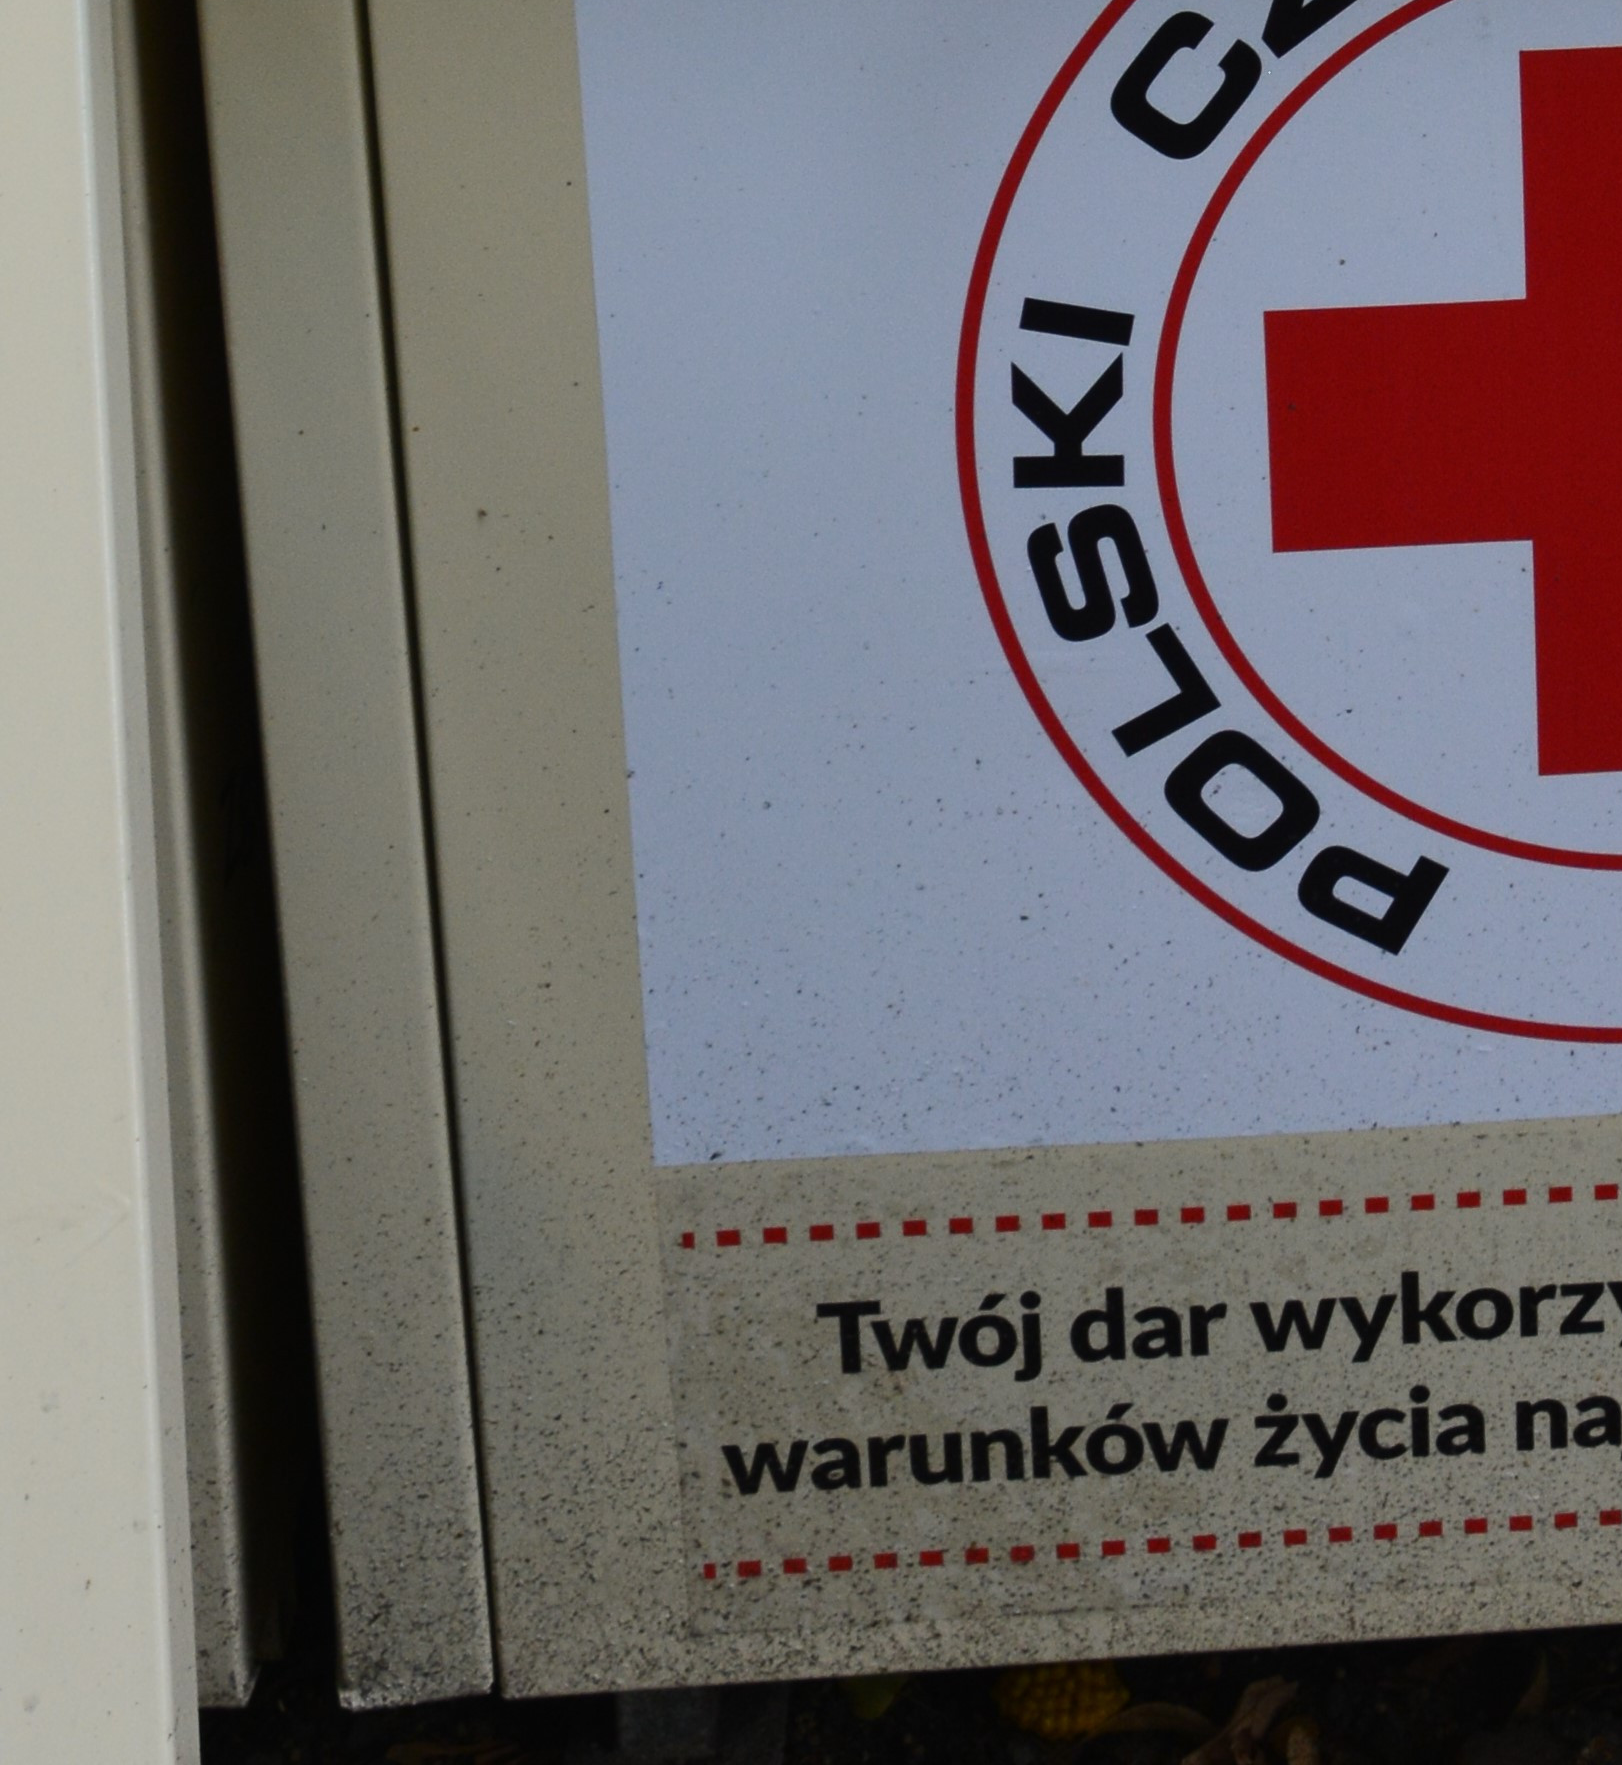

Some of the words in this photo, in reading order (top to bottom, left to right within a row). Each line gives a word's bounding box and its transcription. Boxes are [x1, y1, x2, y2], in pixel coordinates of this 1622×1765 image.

[1012, 299, 1448, 954] POLSKI
[817, 1291, 1042, 1381] Twój
[1070, 1287, 1226, 1362] dar
[722, 1403, 1228, 1496] warunków
[1255, 1385, 1485, 1479] życia
